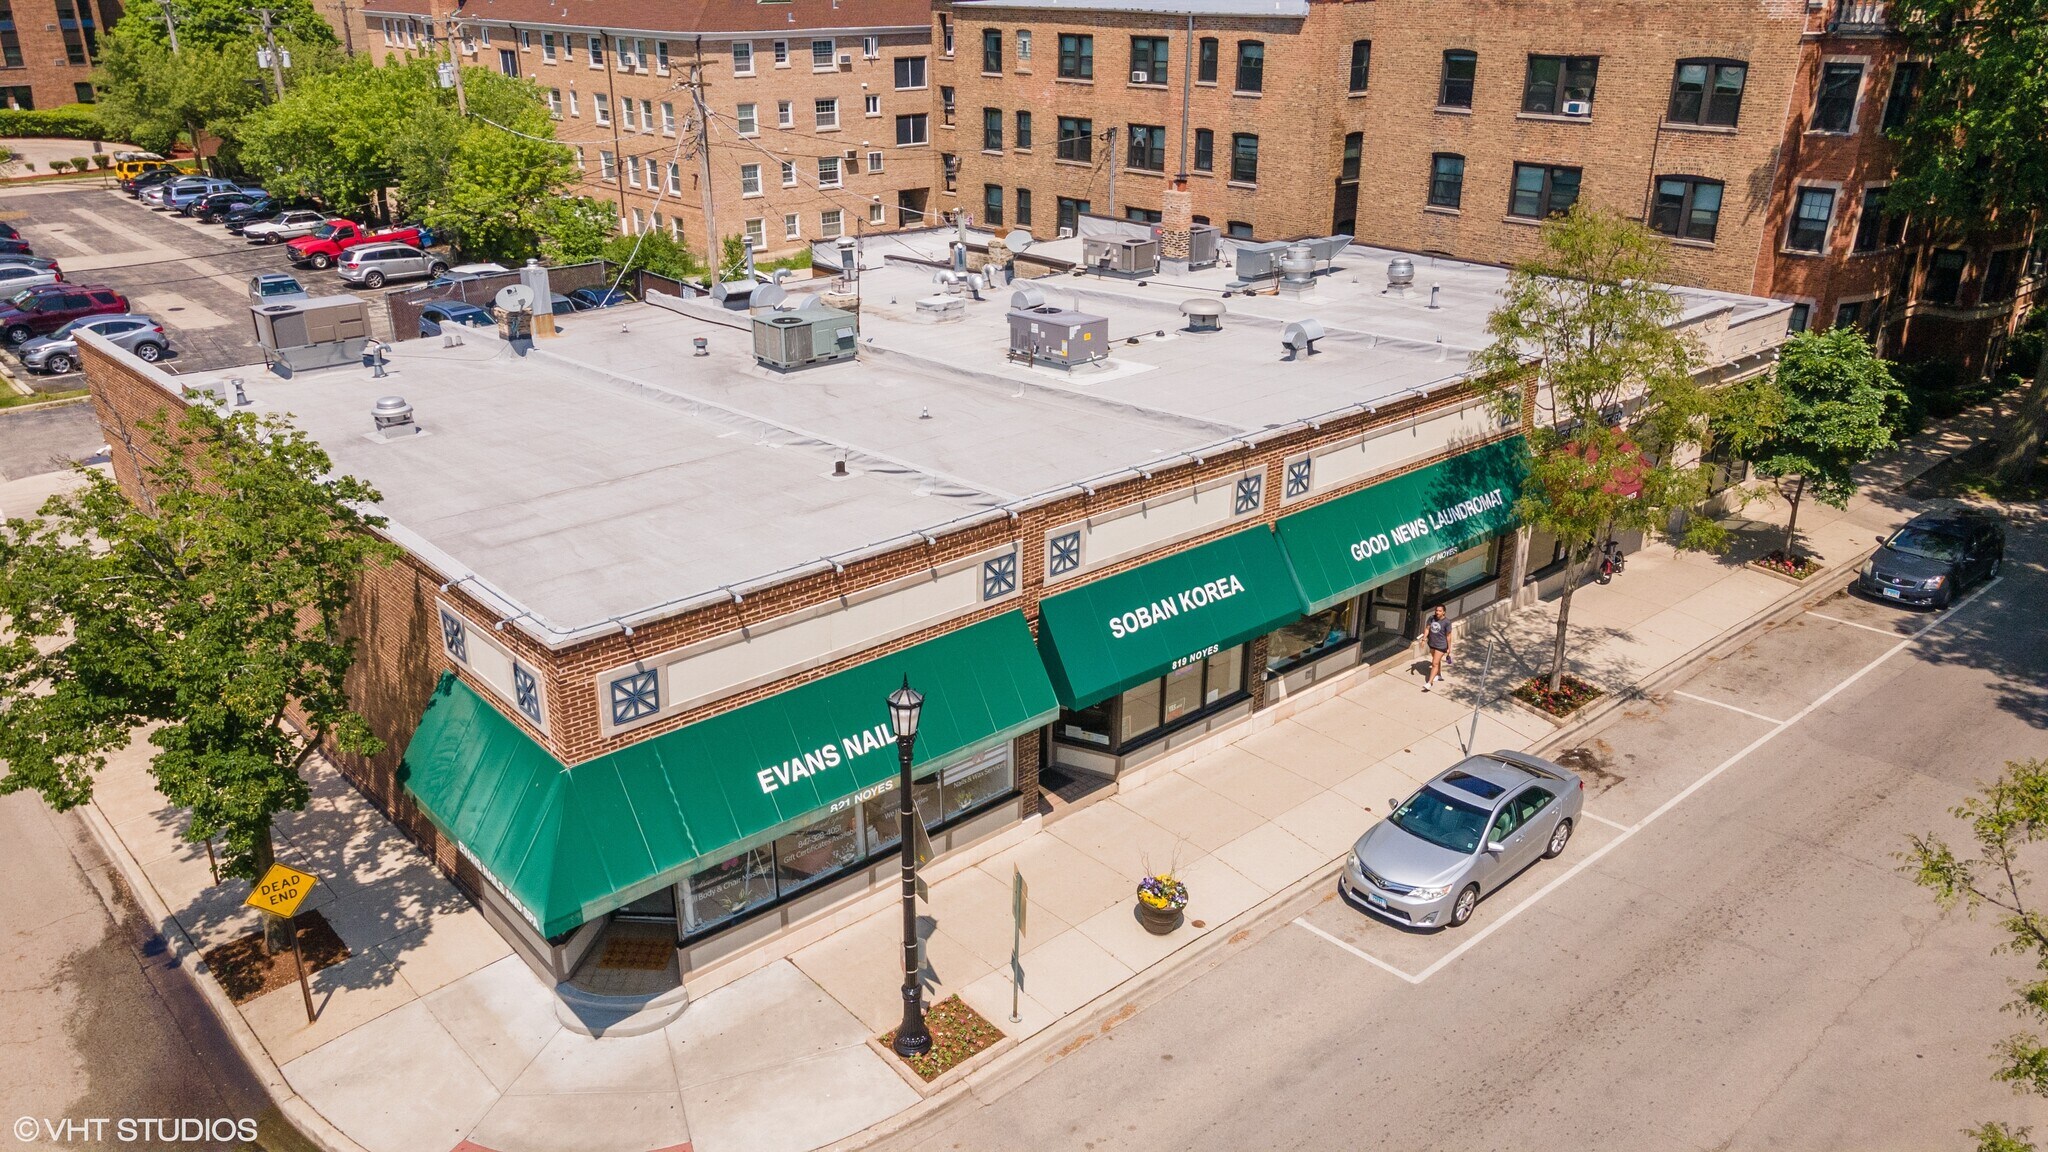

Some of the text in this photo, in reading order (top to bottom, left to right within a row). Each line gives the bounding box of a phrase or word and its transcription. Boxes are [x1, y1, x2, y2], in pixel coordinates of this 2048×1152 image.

[1350, 488, 1503, 562] GOOD NEWS LAUNDROMAT
[1109, 574, 1245, 639] SOBAN KOREA
[1171, 644, 1219, 670] 819 NOYES
[756, 723, 899, 794] EVANS NAIL
[854, 780, 893, 804] NOYES
[261, 875, 300, 895] DEAD
[269, 888, 298, 905] END
[698, 888, 716, 901] Body
[723, 877, 742, 890] Chair
